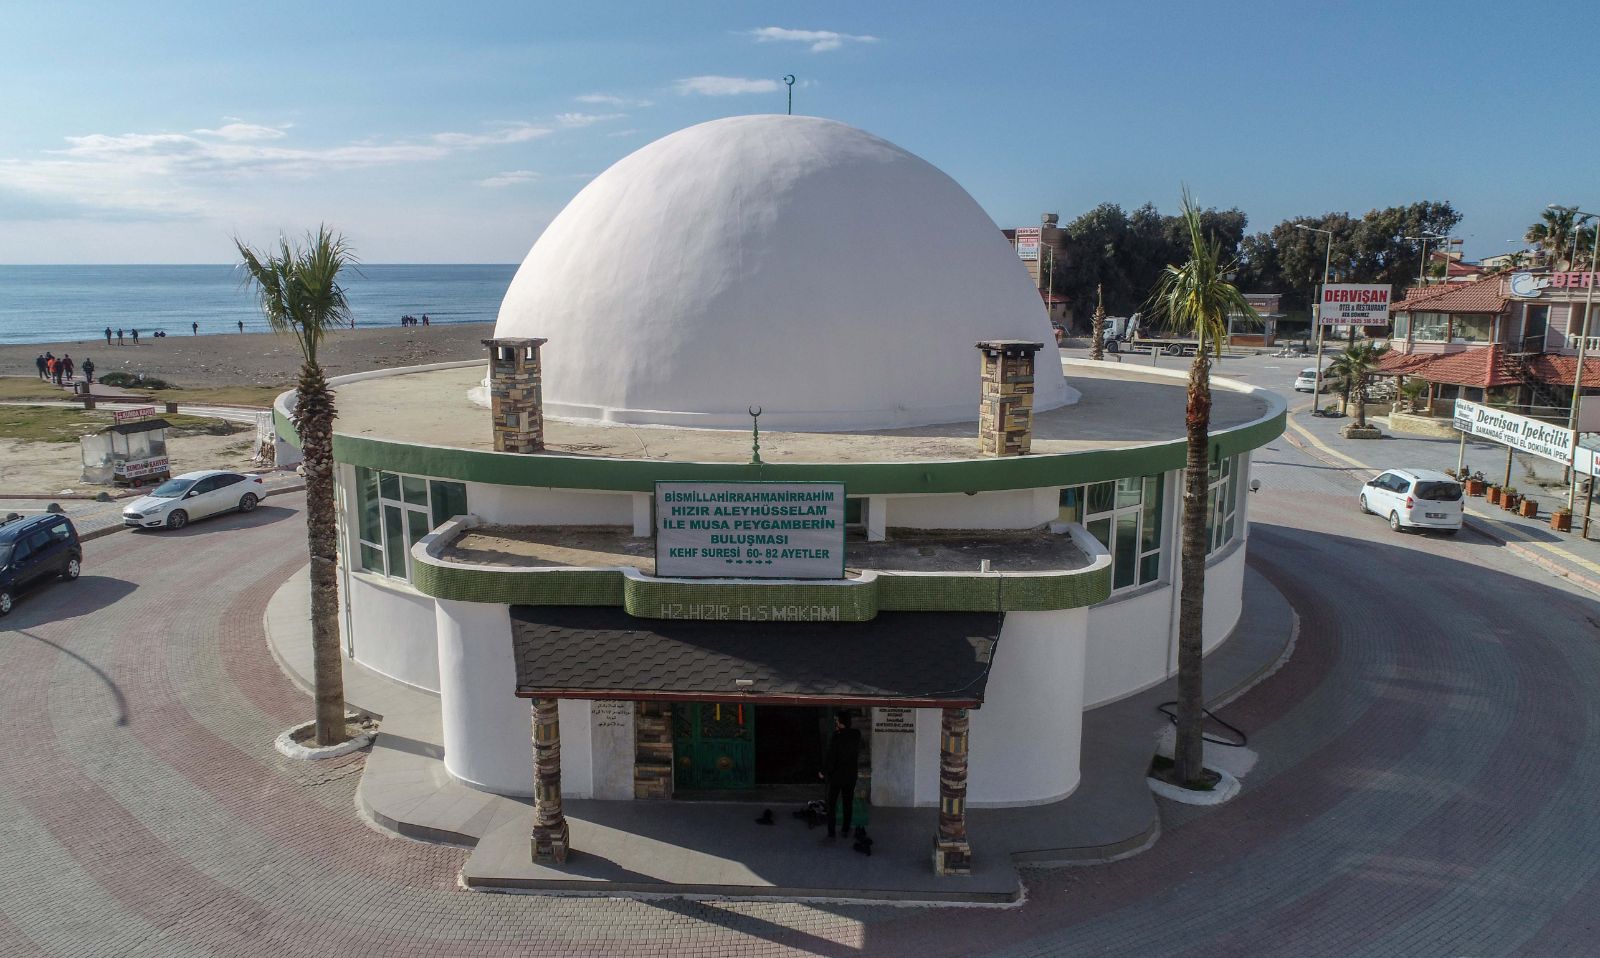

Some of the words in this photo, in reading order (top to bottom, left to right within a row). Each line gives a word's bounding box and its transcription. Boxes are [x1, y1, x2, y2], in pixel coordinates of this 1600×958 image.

[1504, 434, 1520, 446] YERLİ
[1520, 439, 1526, 448] EL
[1528, 442, 1552, 456] DOKUMA
[664, 490, 834, 502] BİSMİLLAHİRRAHMANİRRAHİM
[672, 506, 710, 516] HIZIR
[714, 504, 827, 516] ALEYHÜSSELAM
[664, 518, 686, 530] İLE
[690, 520, 730, 530] MUSA
[734, 518, 835, 530] PEYGAMBERİN
[710, 534, 788, 546] BULUŞMASI
[670, 548, 698, 558] KEHF
[701, 546, 740, 558] SURESİ
[781, 549, 830, 559] AYETLER
[772, 605, 840, 621] MAKAMI
